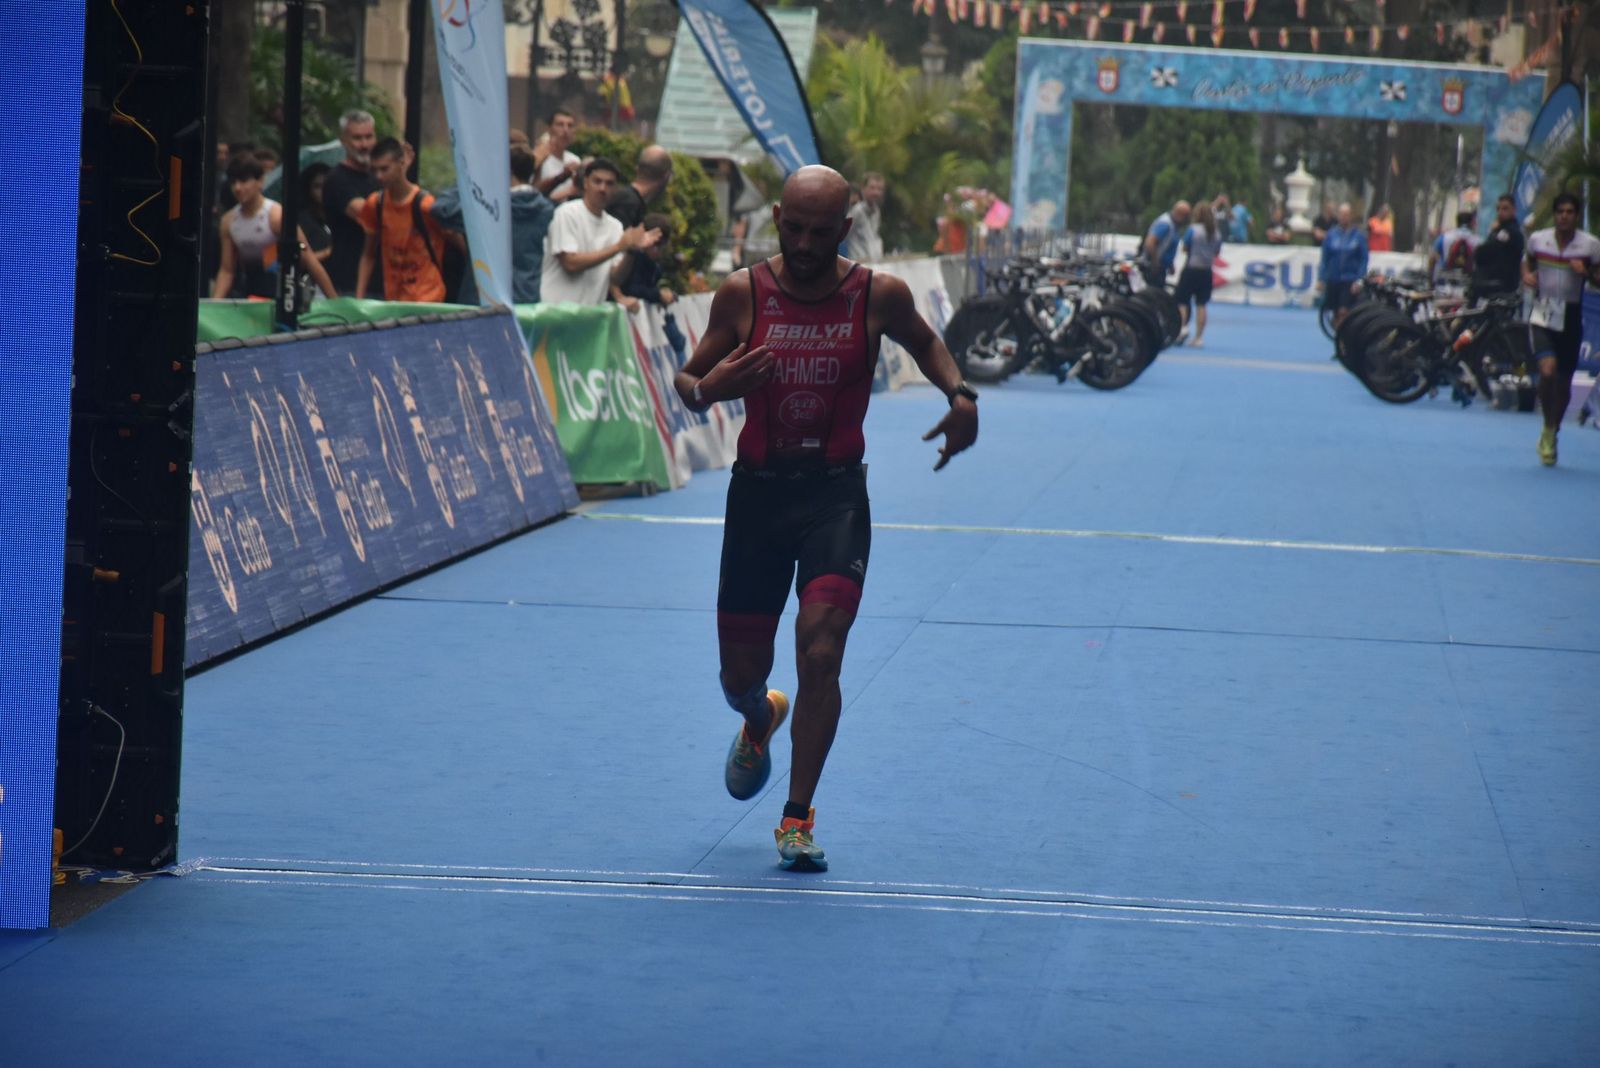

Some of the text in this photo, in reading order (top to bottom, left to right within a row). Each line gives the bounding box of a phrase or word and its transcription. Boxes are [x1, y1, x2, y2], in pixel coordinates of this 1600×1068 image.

[283, 265, 295, 312] GUIL
[766, 323, 853, 339] ISBILYA
[773, 357, 841, 385] AHMED
[351, 469, 392, 531] Ceuta
[223, 505, 273, 576] Ceuta
